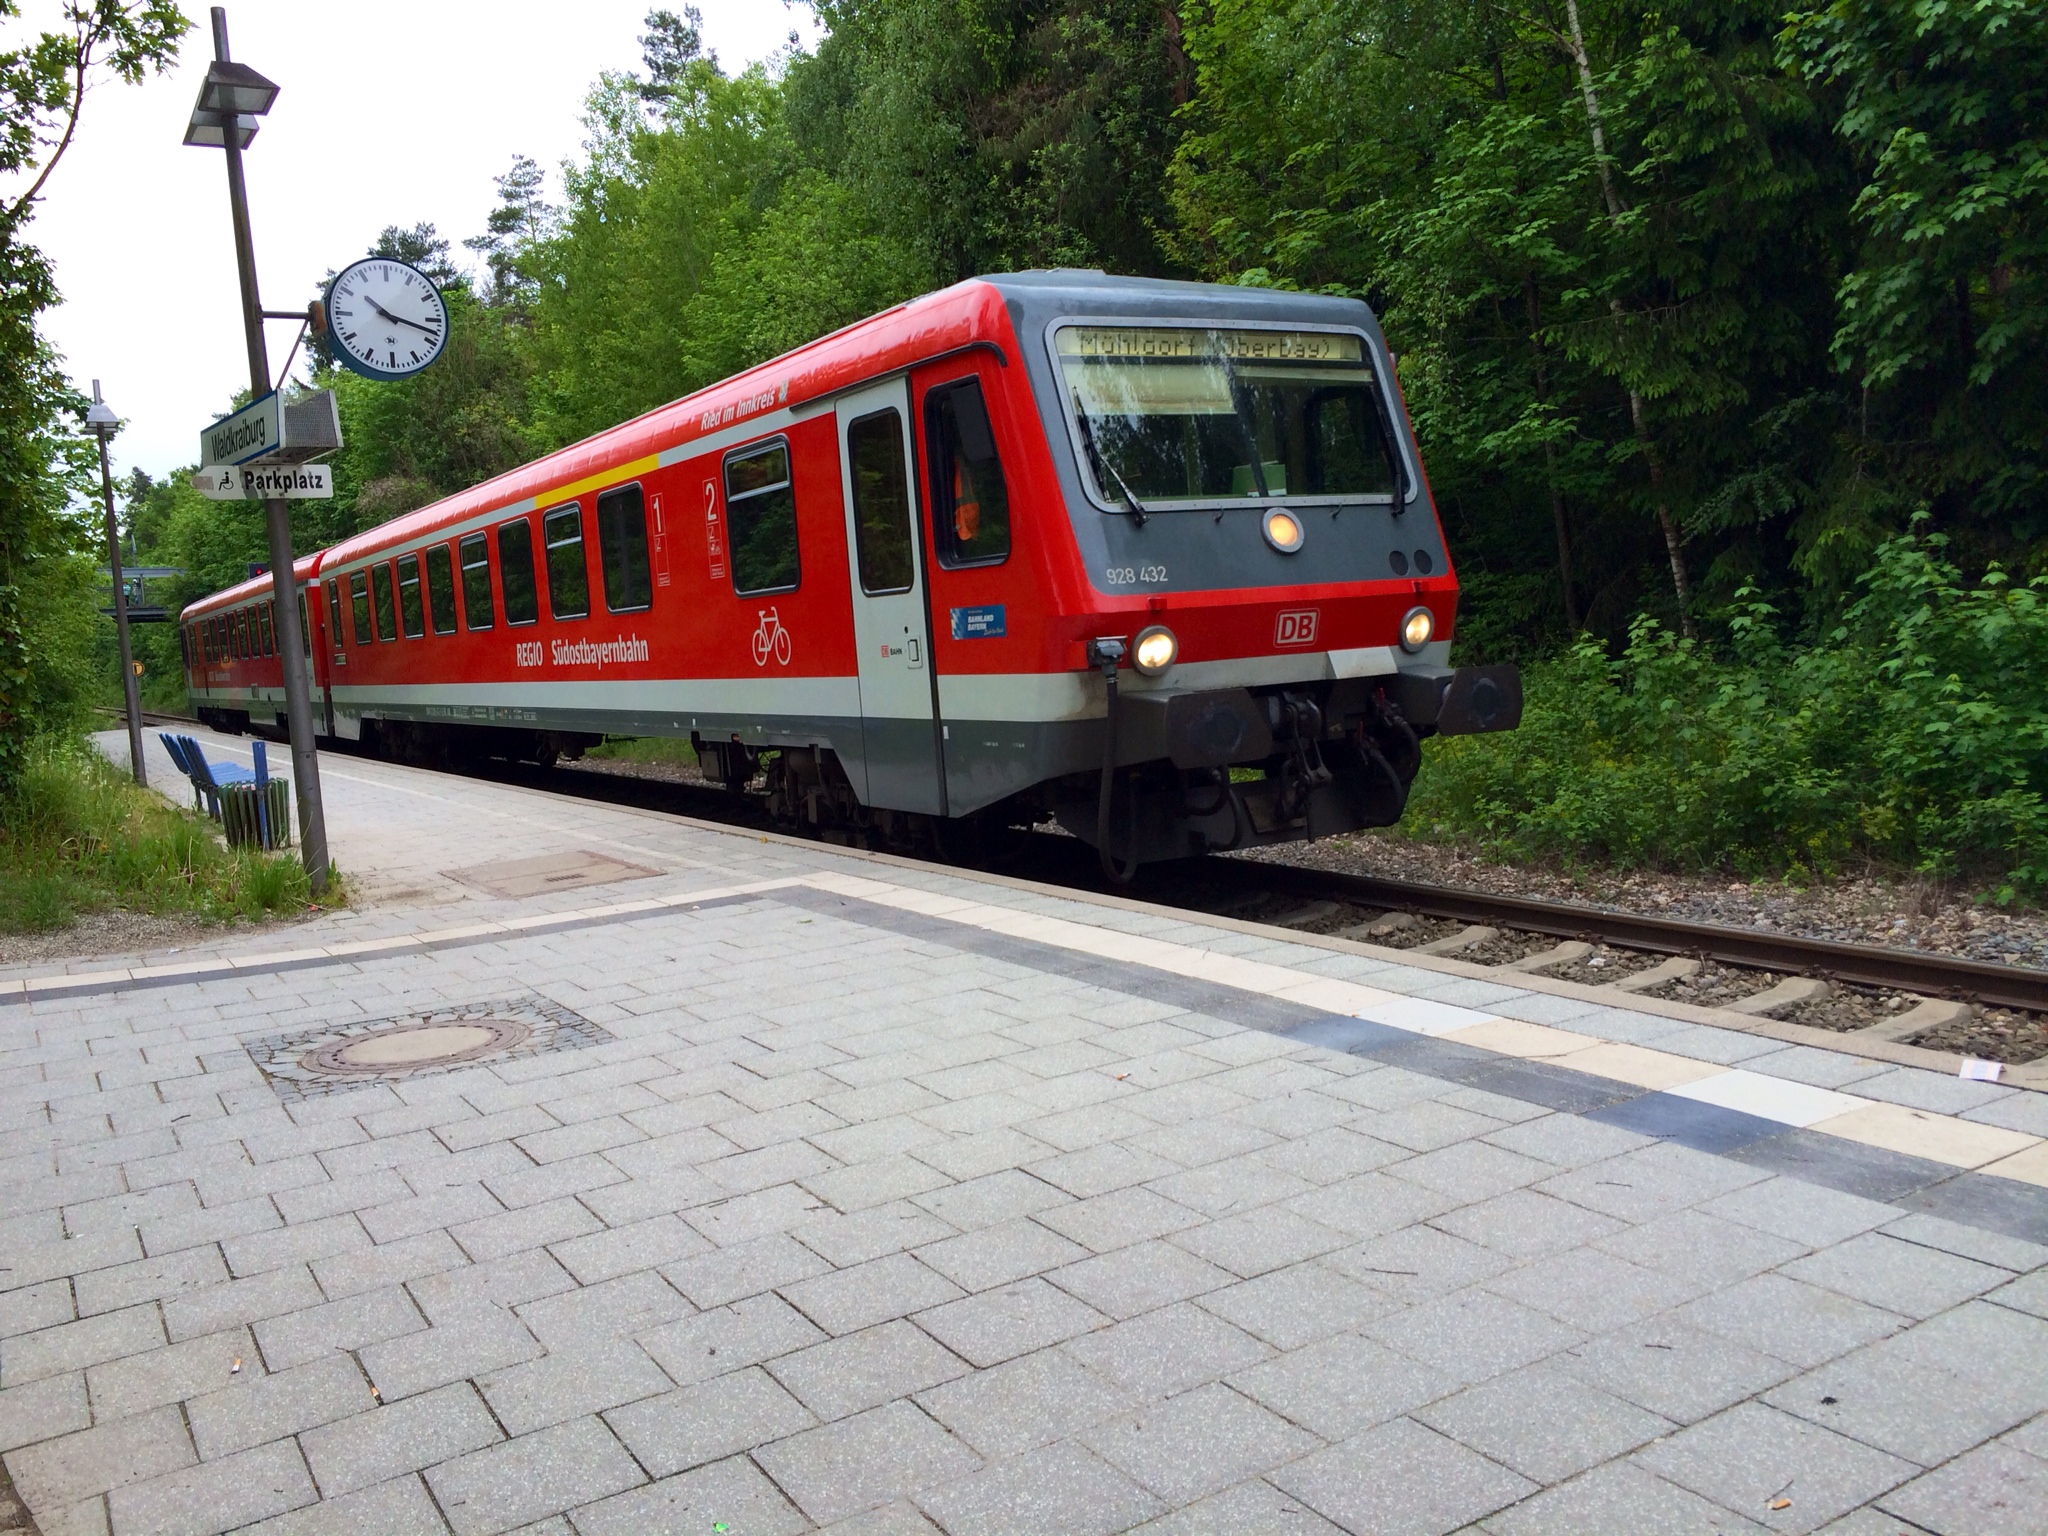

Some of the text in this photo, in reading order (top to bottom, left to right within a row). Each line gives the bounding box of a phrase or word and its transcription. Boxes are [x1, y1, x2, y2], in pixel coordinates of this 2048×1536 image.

[701, 384, 775, 432] Ried im Innkreis
[211, 416, 267, 462] Waldkraiburg
[244, 470, 323, 493] Parkplatz
[653, 497, 662, 532] 1
[705, 483, 717, 520] 2
[1106, 566, 1168, 584] 928 432
[1280, 614, 1314, 641] DB
[516, 632, 649, 670] REGIO Südostbayernbahn
